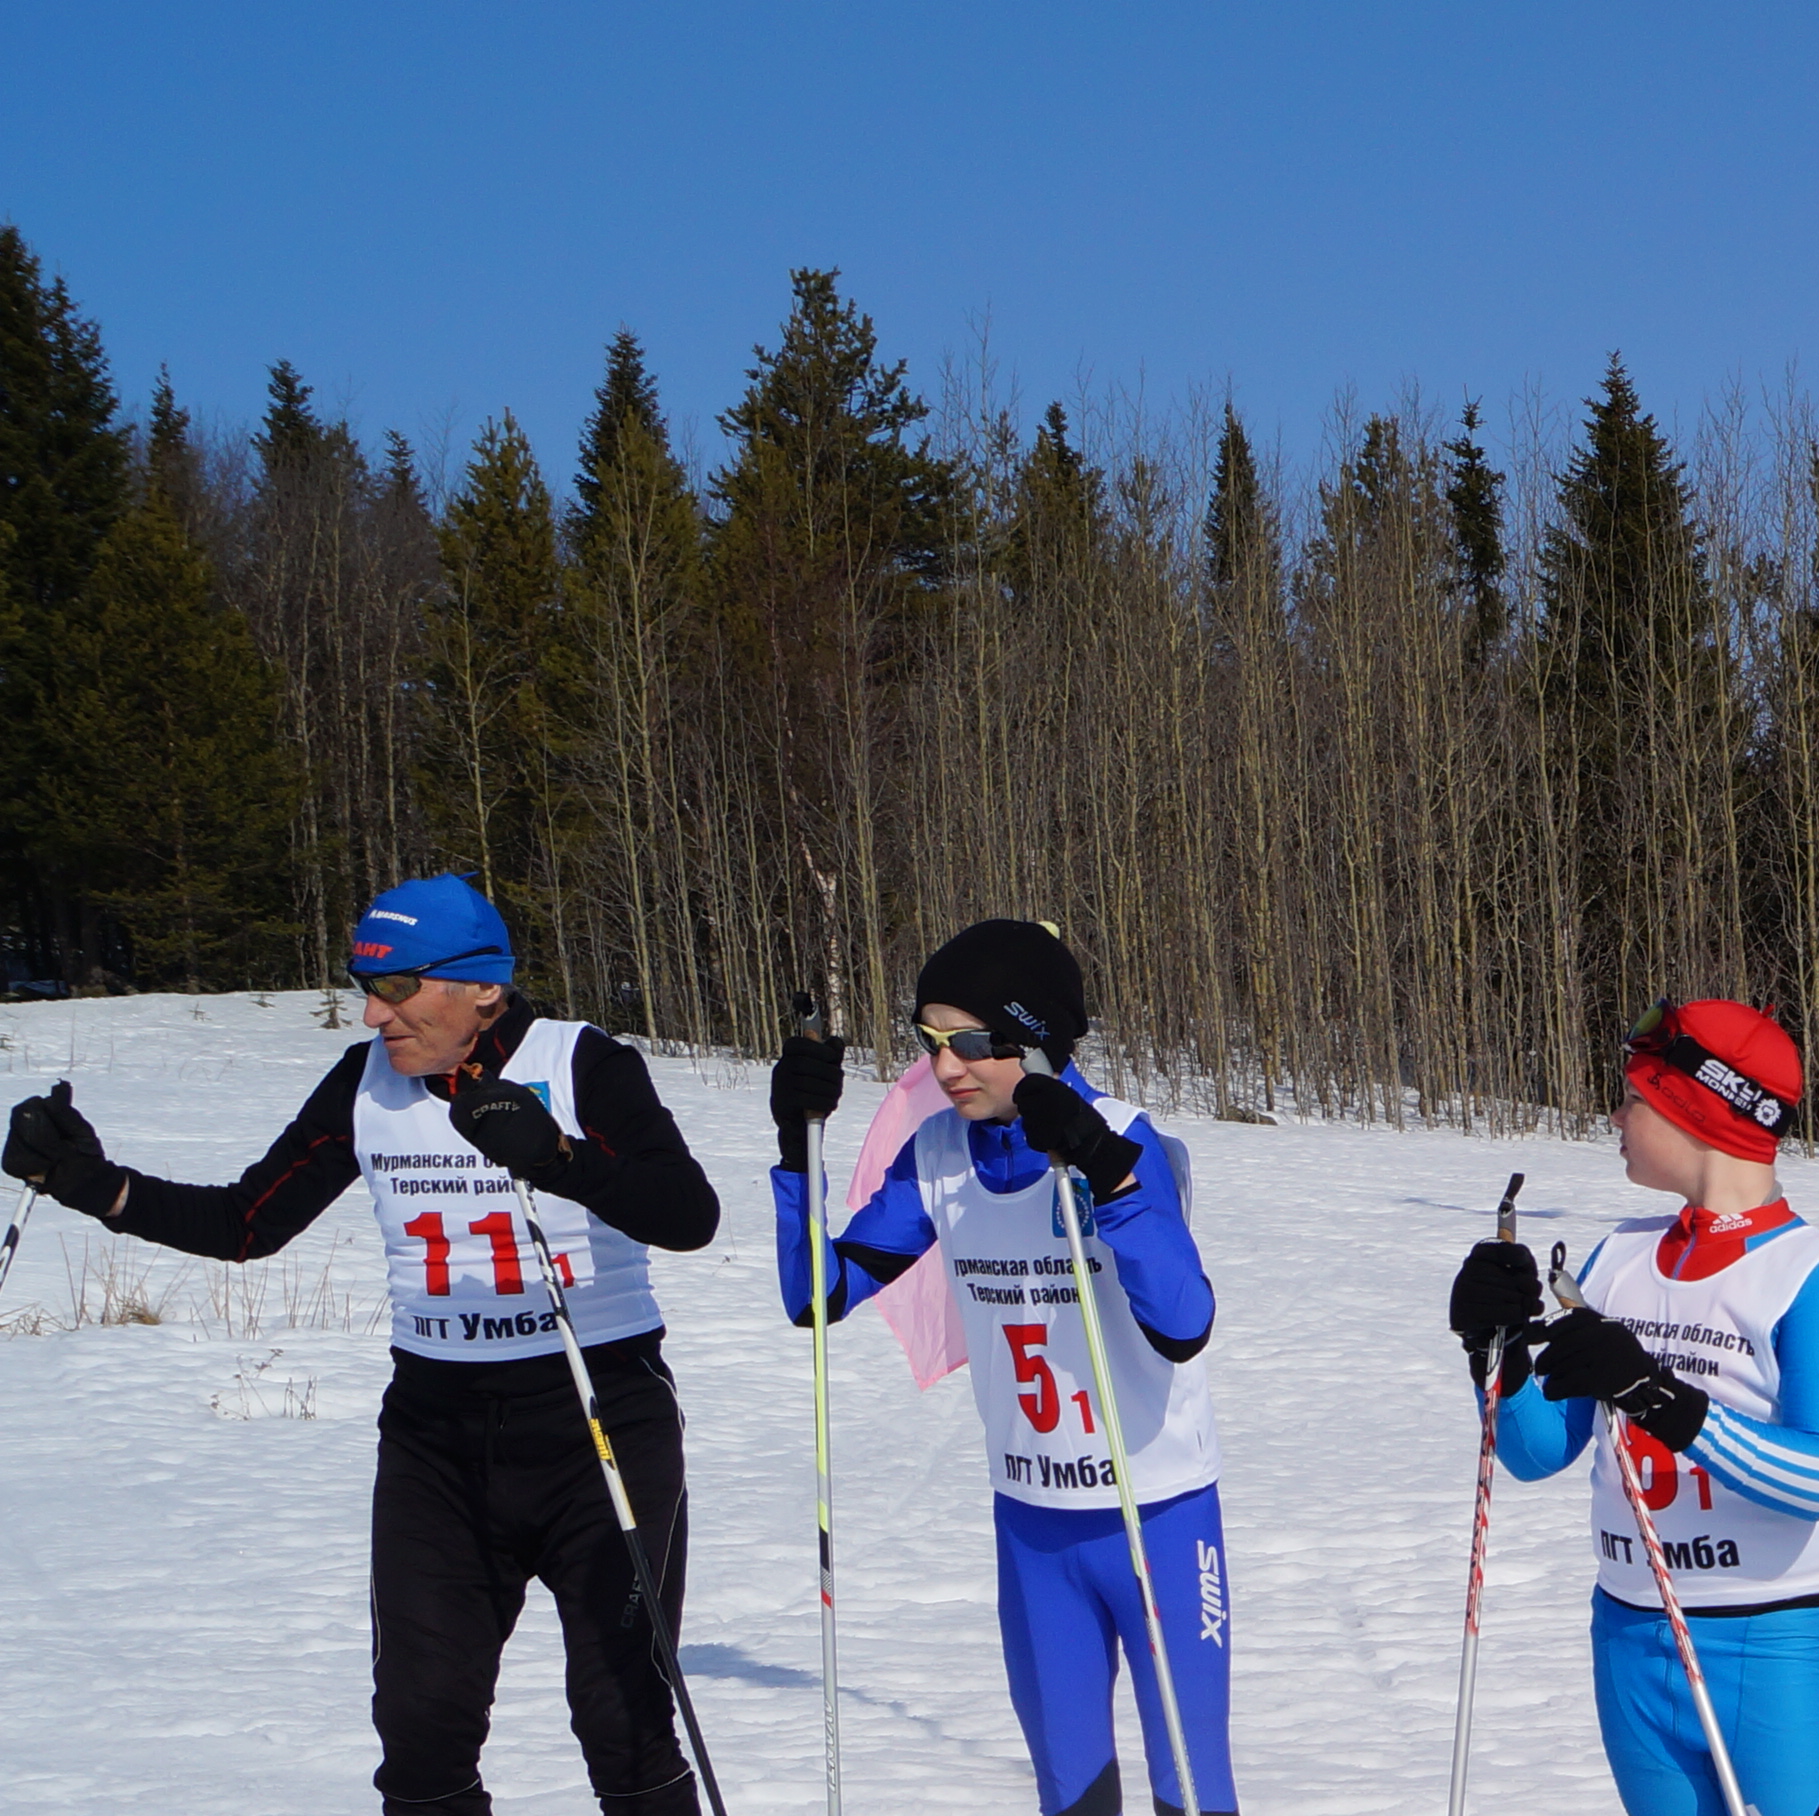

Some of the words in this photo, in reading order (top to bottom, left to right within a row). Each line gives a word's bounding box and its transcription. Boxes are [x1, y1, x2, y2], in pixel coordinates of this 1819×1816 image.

[371, 1153, 477, 1171] Мурманская
[391, 1176, 468, 1196] Терский
[1709, 1216, 1753, 1235] adidas
[404, 1211, 525, 1296] 11
[551, 1253, 575, 1289] 1
[966, 1281, 1026, 1306] Терский
[1030, 1284, 1080, 1305] район
[458, 1311, 558, 1342] Умба
[1681, 1322, 1756, 1357] область
[1003, 1323, 1061, 1434] 5
[1071, 1389, 1095, 1434] 1
[1006, 1453, 1033, 1486] пгт
[1039, 1454, 1116, 1490] Умба
[1689, 1466, 1713, 1511] 1
[1600, 1529, 1633, 1564] пгт
